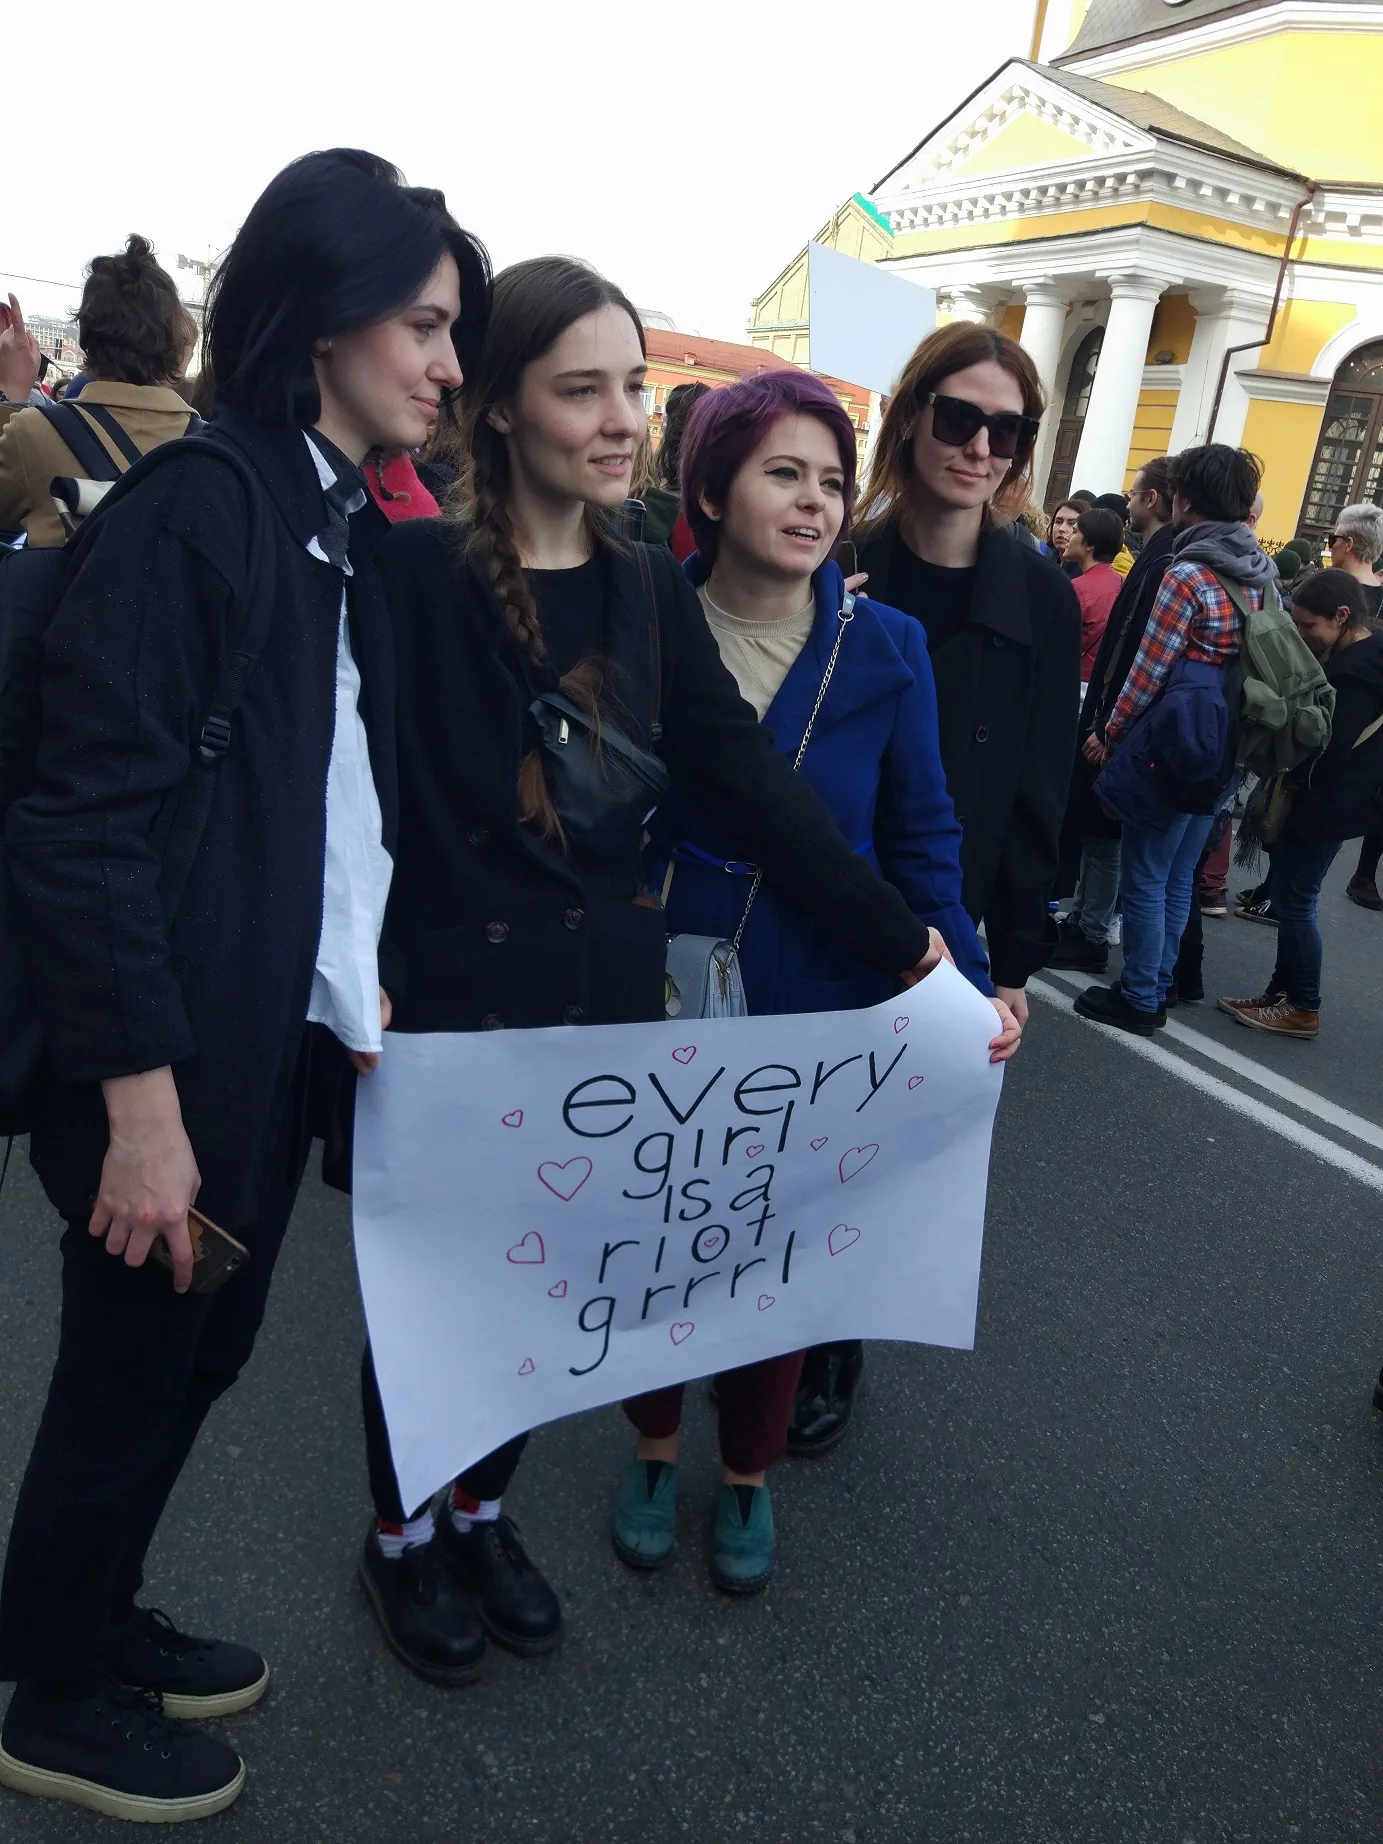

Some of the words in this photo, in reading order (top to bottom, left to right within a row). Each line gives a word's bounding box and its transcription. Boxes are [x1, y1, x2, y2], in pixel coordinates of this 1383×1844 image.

[562, 1043, 908, 1138] every
[622, 1100, 794, 1200] girl
[663, 1178, 712, 1224] is
[729, 1163, 775, 1212] a
[599, 1203, 776, 1284] riot
[568, 1230, 796, 1376] grrrl
